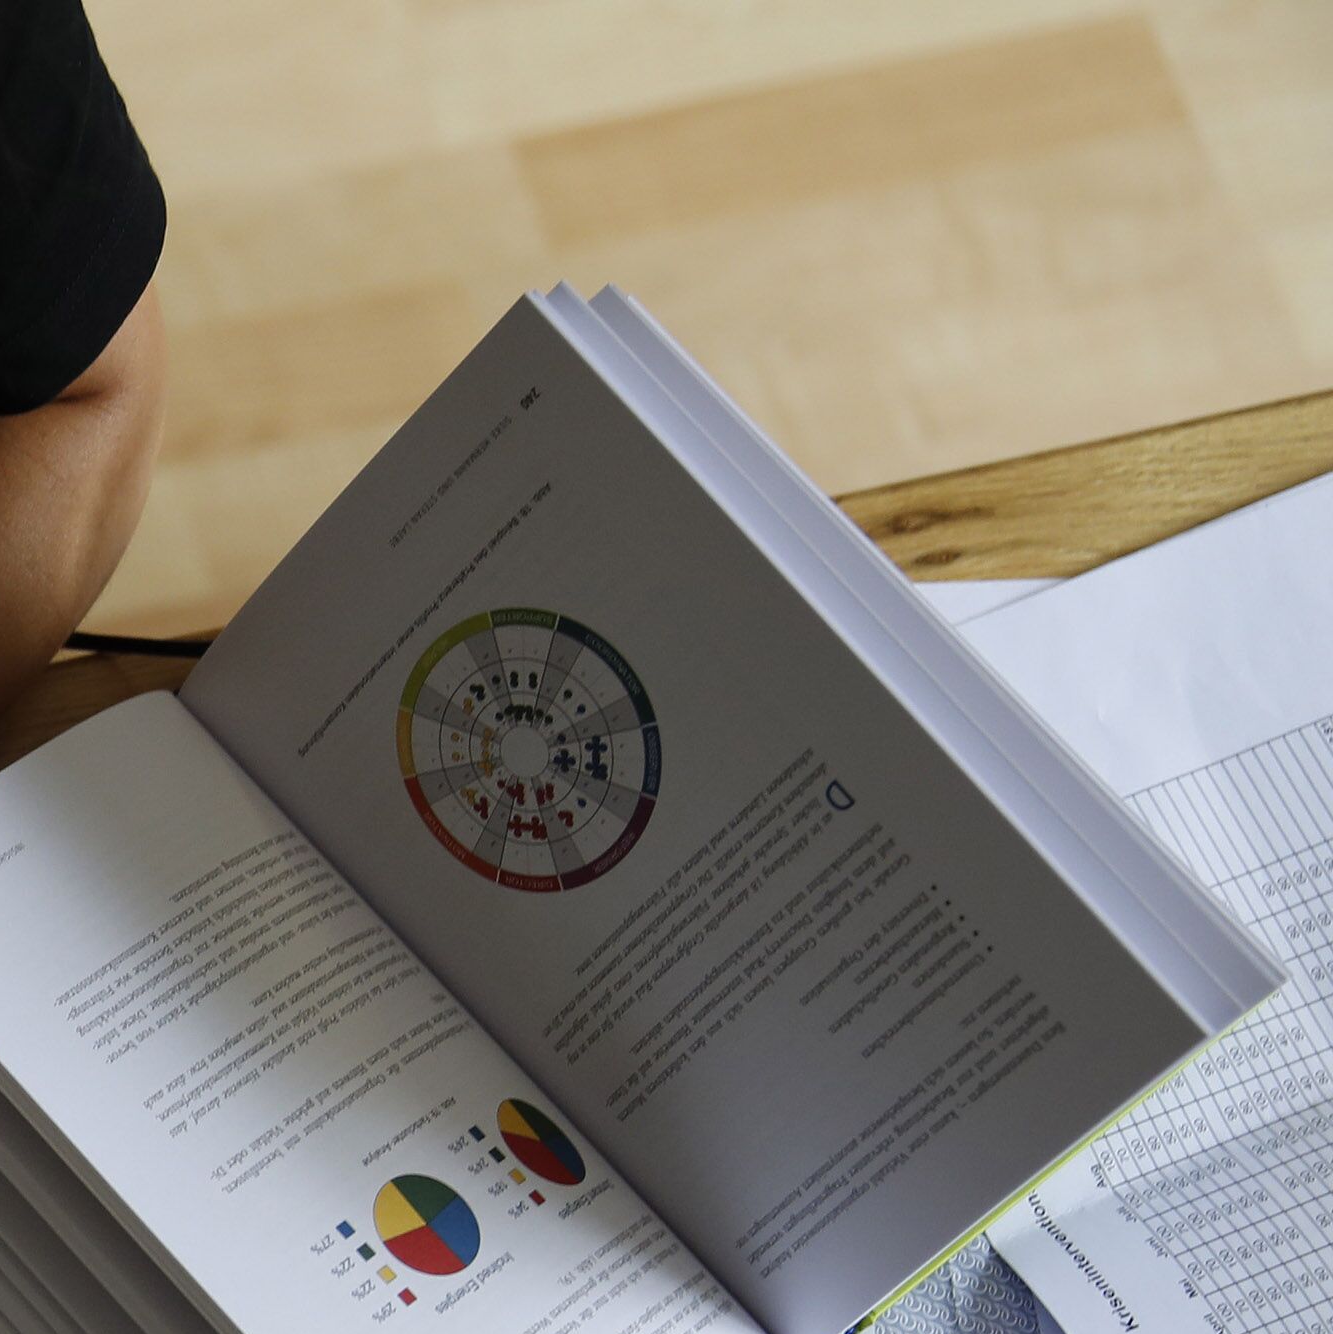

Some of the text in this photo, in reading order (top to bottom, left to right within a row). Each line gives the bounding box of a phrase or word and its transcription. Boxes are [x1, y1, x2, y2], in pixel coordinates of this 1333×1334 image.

[819, 778, 856, 815] D
[64, 983, 115, 1025] Führungs-
[119, 1009, 147, 1033] Diese
[135, 1002, 187, 1041] Faktor von
[222, 1068, 261, 1101] Hinweise
[142, 1089, 166, 1111] auch
[167, 1119, 189, 1139] dass
[248, 1124, 283, 1153] Vielfalt
[220, 1134, 302, 1198] mit beeinflussen,
[226, 1148, 249, 1170] oder
[1086, 1162, 1112, 1189] Aug
[308, 1234, 335, 1258] 27%
[328, 1256, 356, 1280] 22%
[349, 1278, 376, 1302] 22%
[431, 1251, 514, 1318] Inclined Energies
[1178, 1276, 1199, 1299] Mai
